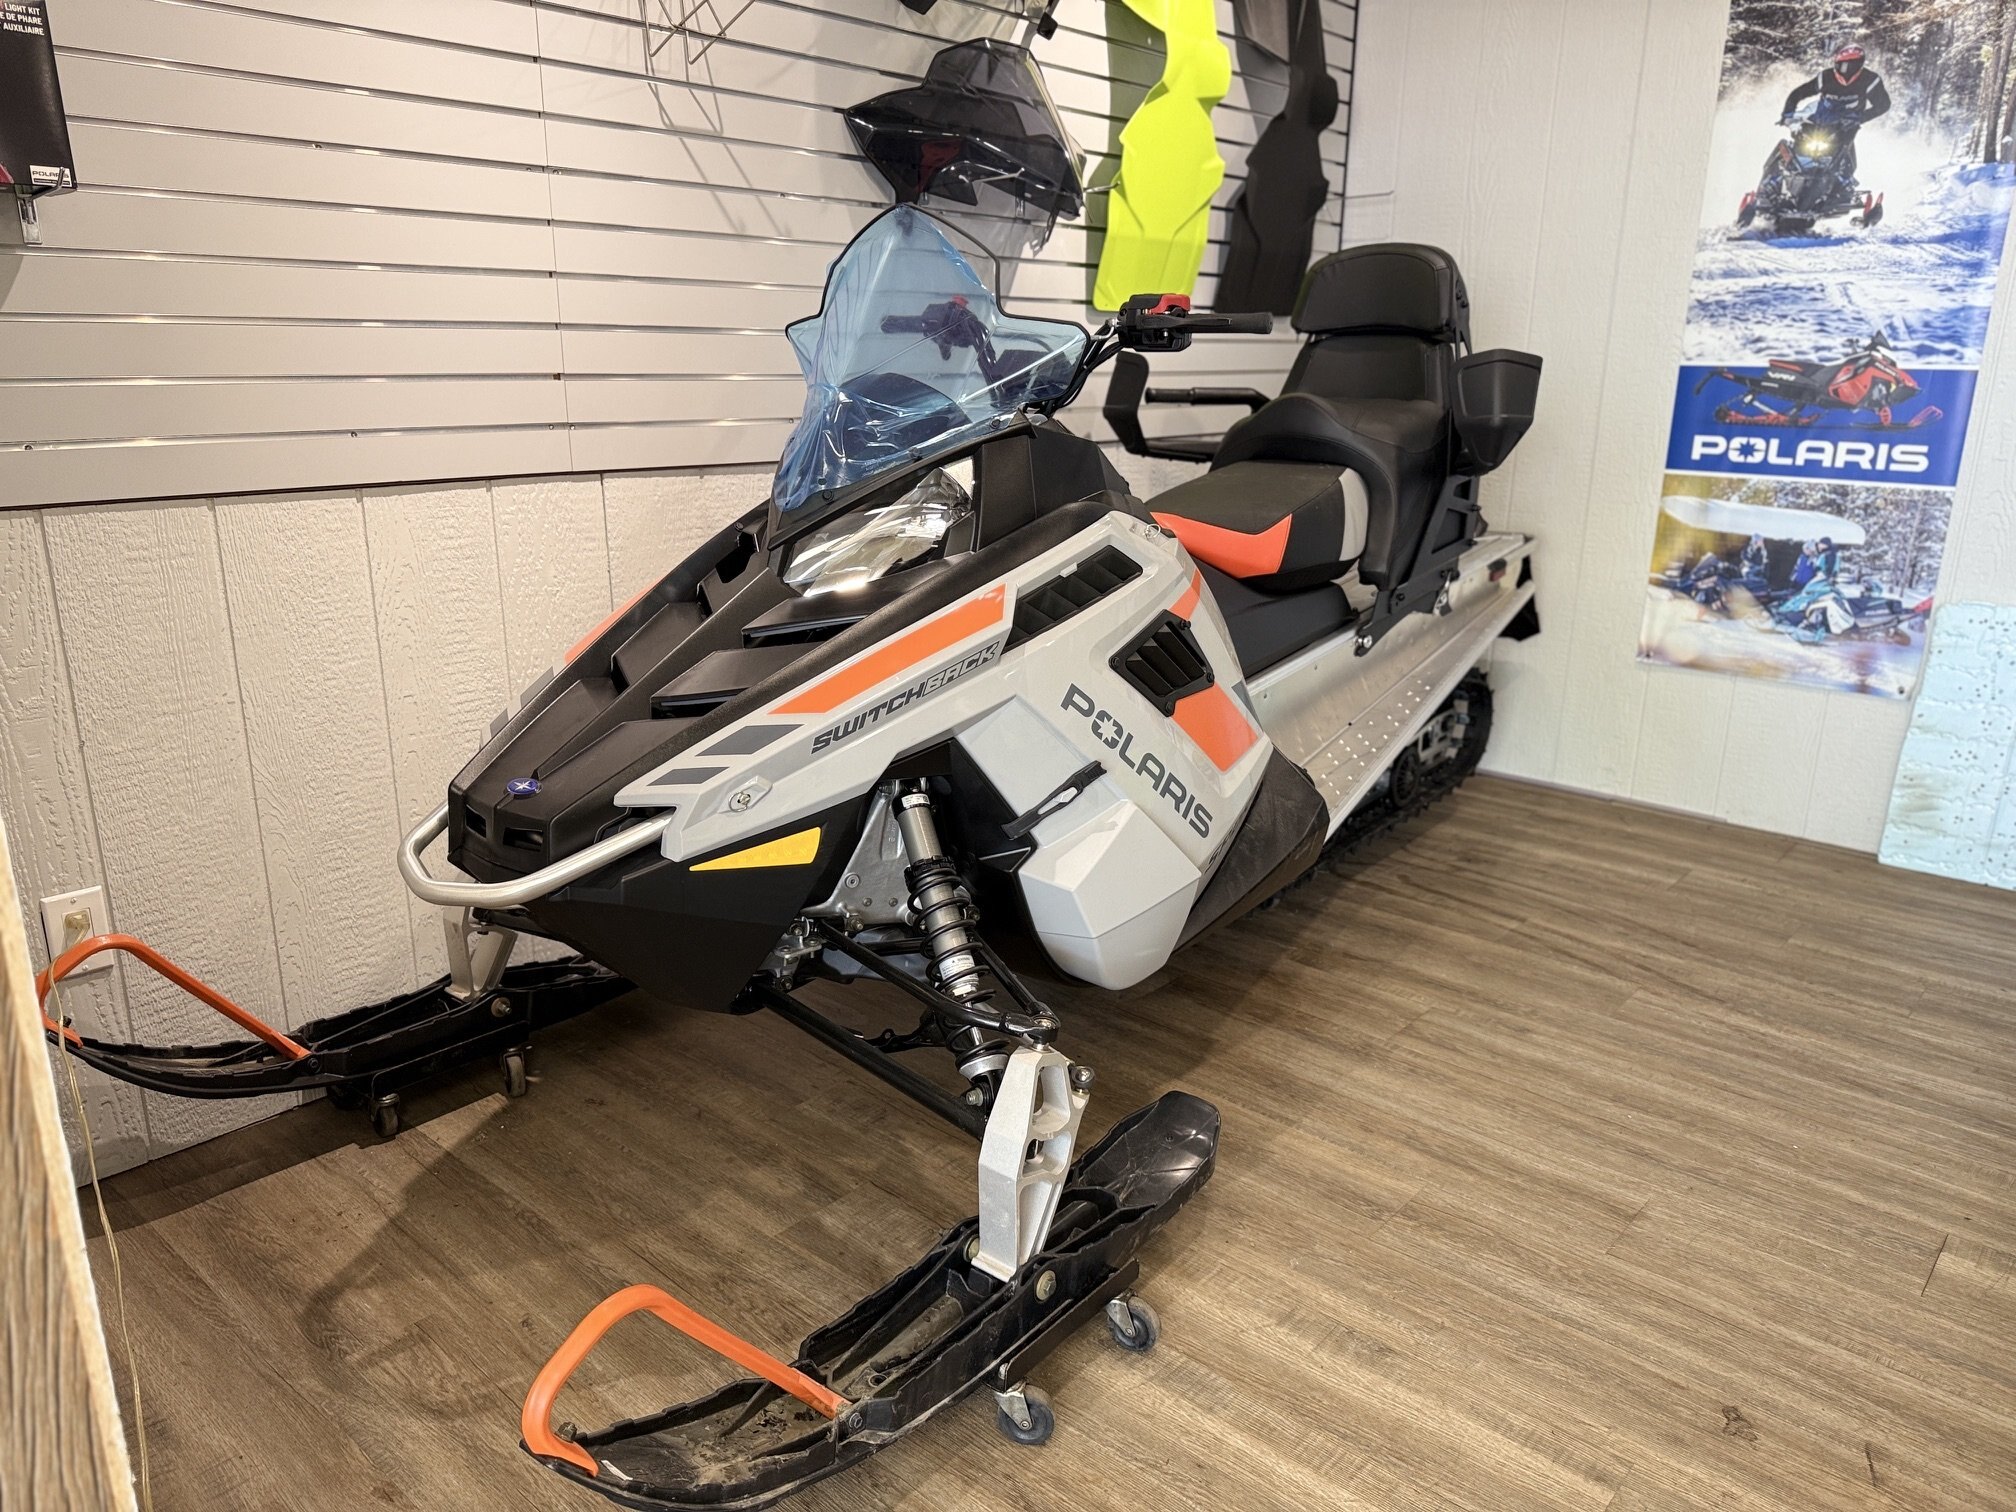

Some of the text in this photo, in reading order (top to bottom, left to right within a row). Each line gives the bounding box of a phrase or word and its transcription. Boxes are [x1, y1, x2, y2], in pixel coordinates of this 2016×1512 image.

[4, 3, 40, 16] LIGHT KIT
[6, 12, 17, 21] DE
[17, 14, 43, 25] PHARE
[3, 22, 45, 36] AUXILIAIRE
[32, 171, 69, 179] POLARS
[1691, 434, 1929, 473] POLARIS
[811, 641, 1000, 755] SWITCHBACK
[1060, 683, 1213, 839] POLARIS
